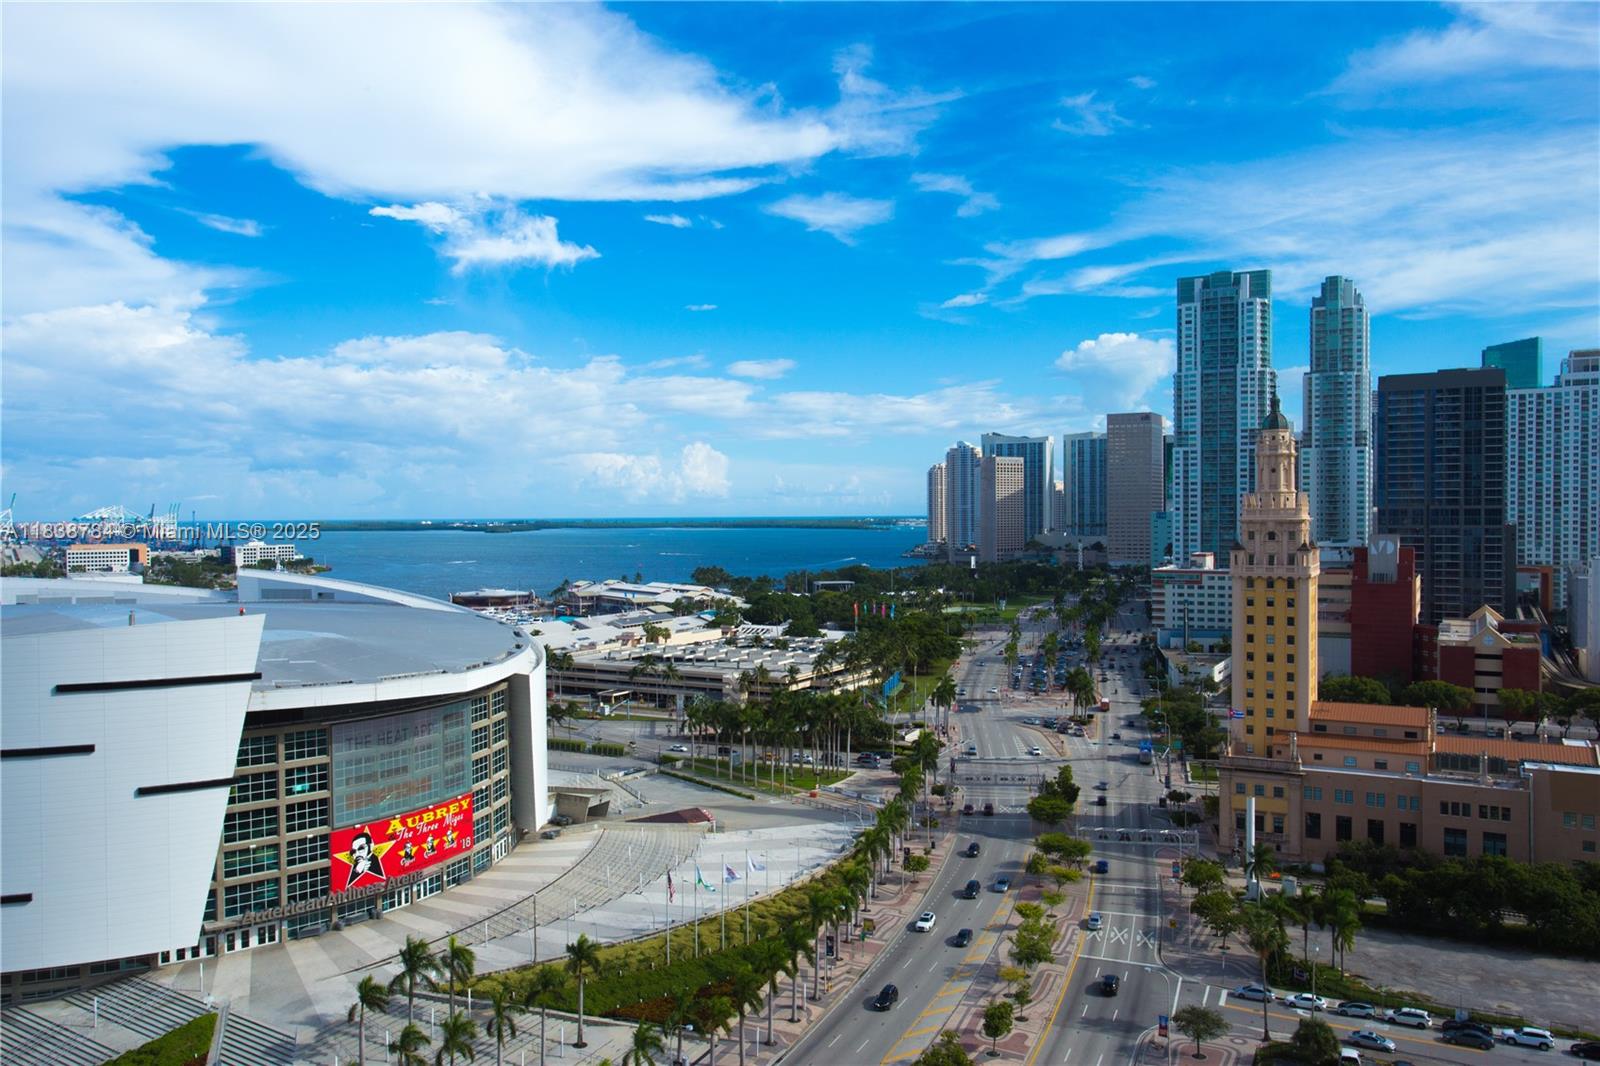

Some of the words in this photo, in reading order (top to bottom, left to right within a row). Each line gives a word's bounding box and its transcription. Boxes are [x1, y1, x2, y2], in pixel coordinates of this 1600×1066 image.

[377, 728, 409, 745] HEAT
[386, 798, 470, 834] AUBREY
[396, 826, 413, 841] The
[416, 821, 439, 836] Three
[387, 871, 424, 890] Arena
